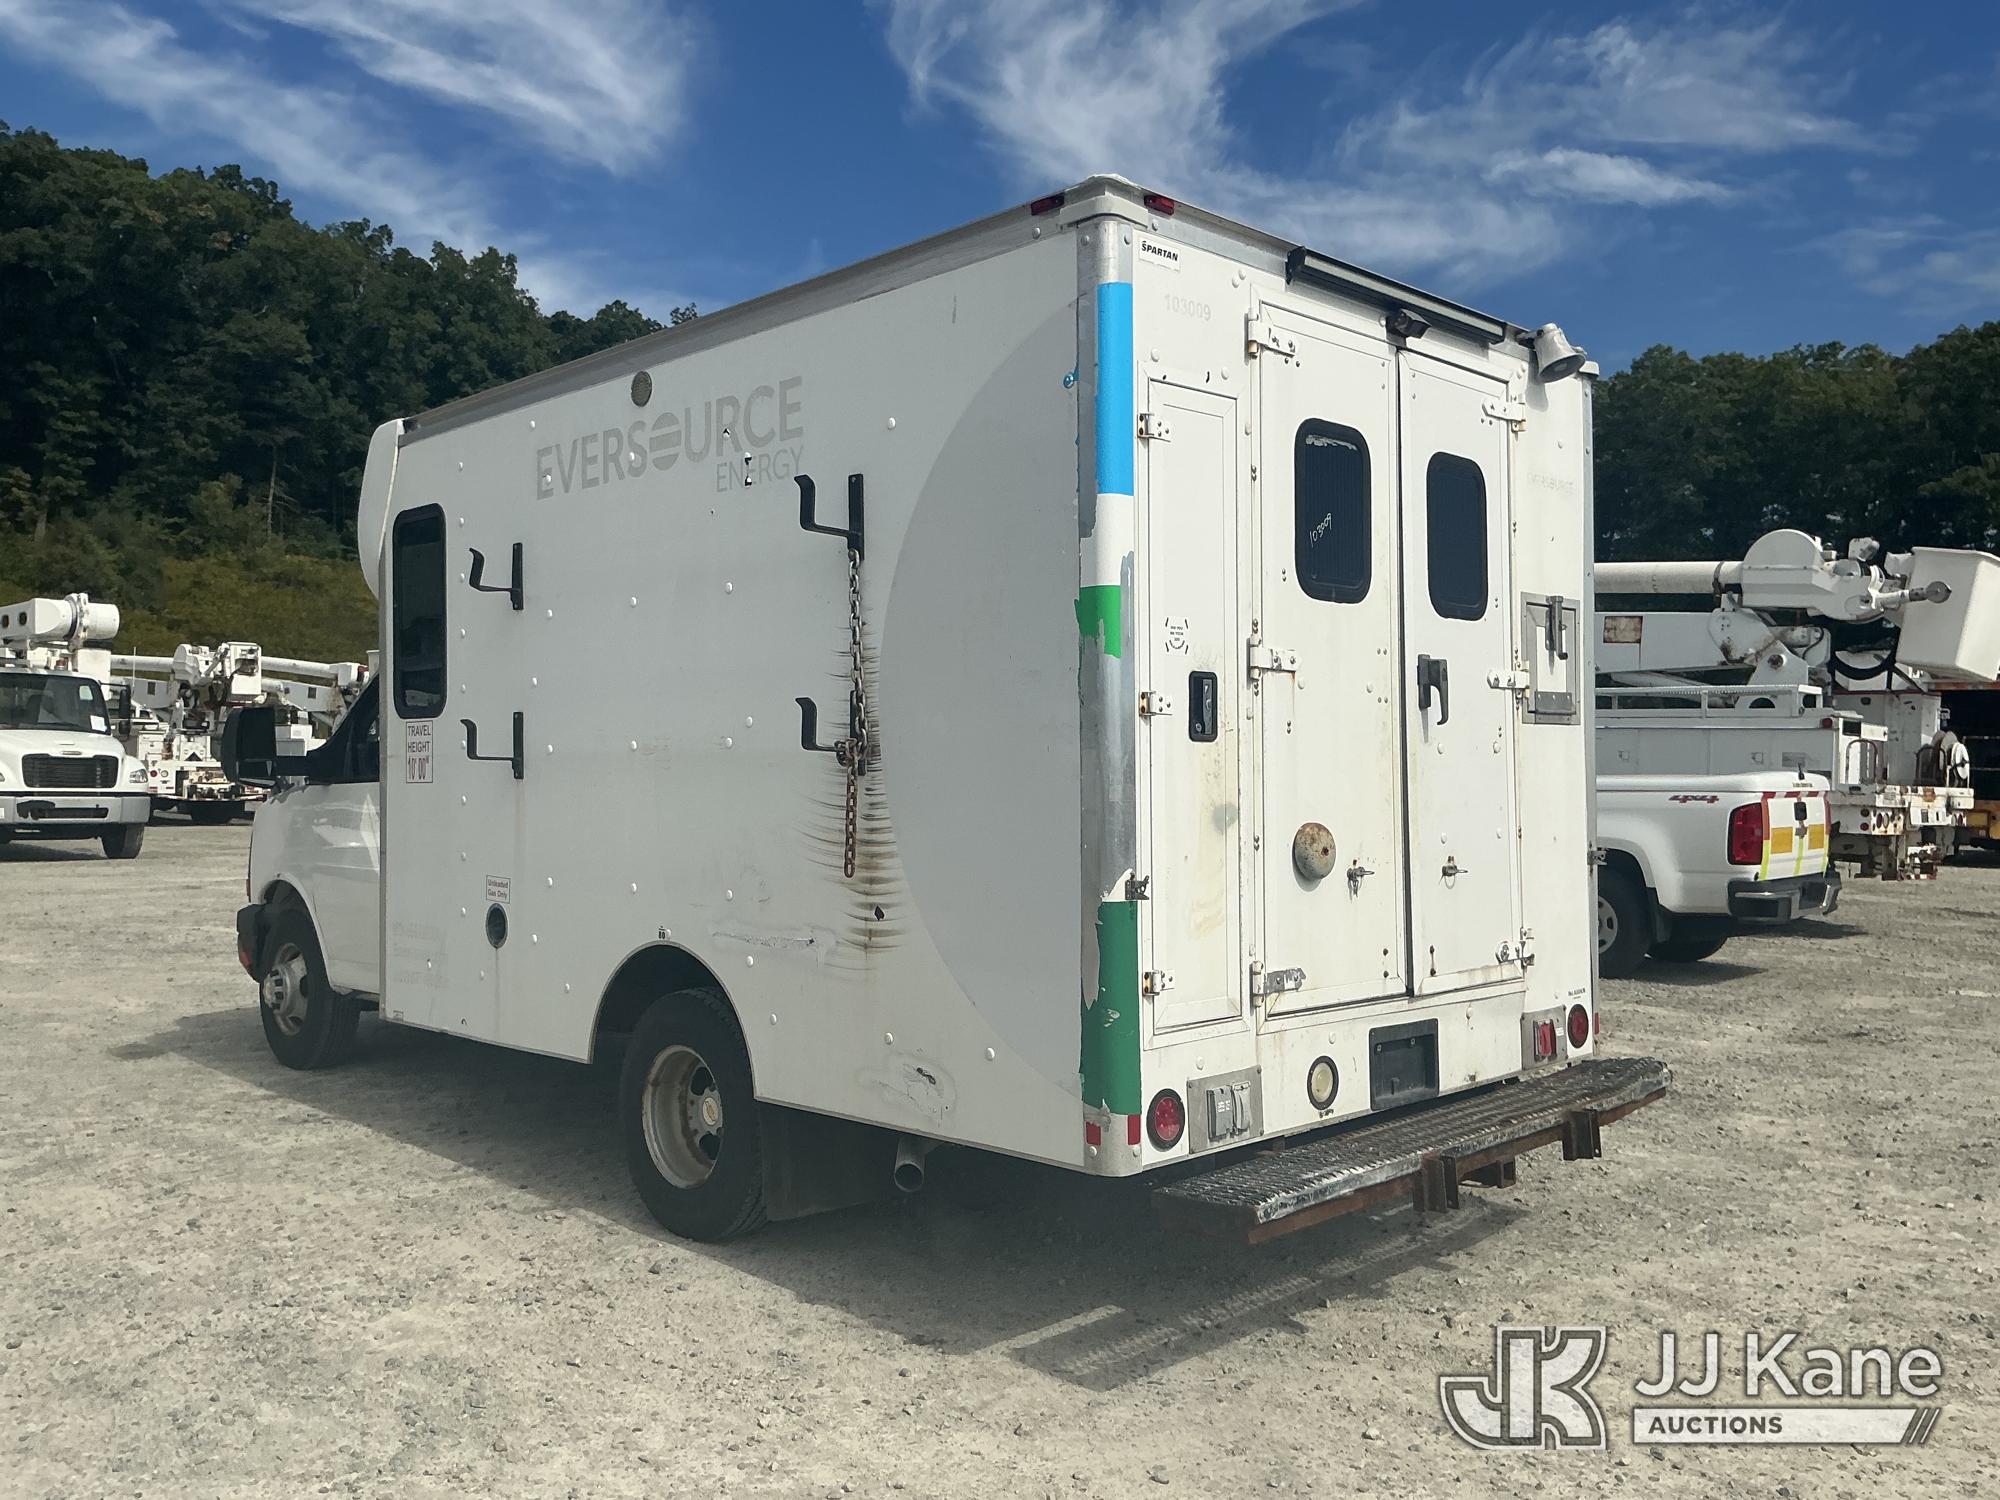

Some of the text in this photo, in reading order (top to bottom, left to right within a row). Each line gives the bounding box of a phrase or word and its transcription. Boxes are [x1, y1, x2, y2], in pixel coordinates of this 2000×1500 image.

[1141, 240, 1179, 262] SPARTAN
[1164, 293, 1212, 322] 103009
[536, 376, 804, 500] EVERSOURCE
[716, 445, 805, 493] ENERGY
[1309, 512, 1332, 549] 103009
[408, 724, 431, 737] TRAVEL
[408, 740, 430, 753] HEIGHT
